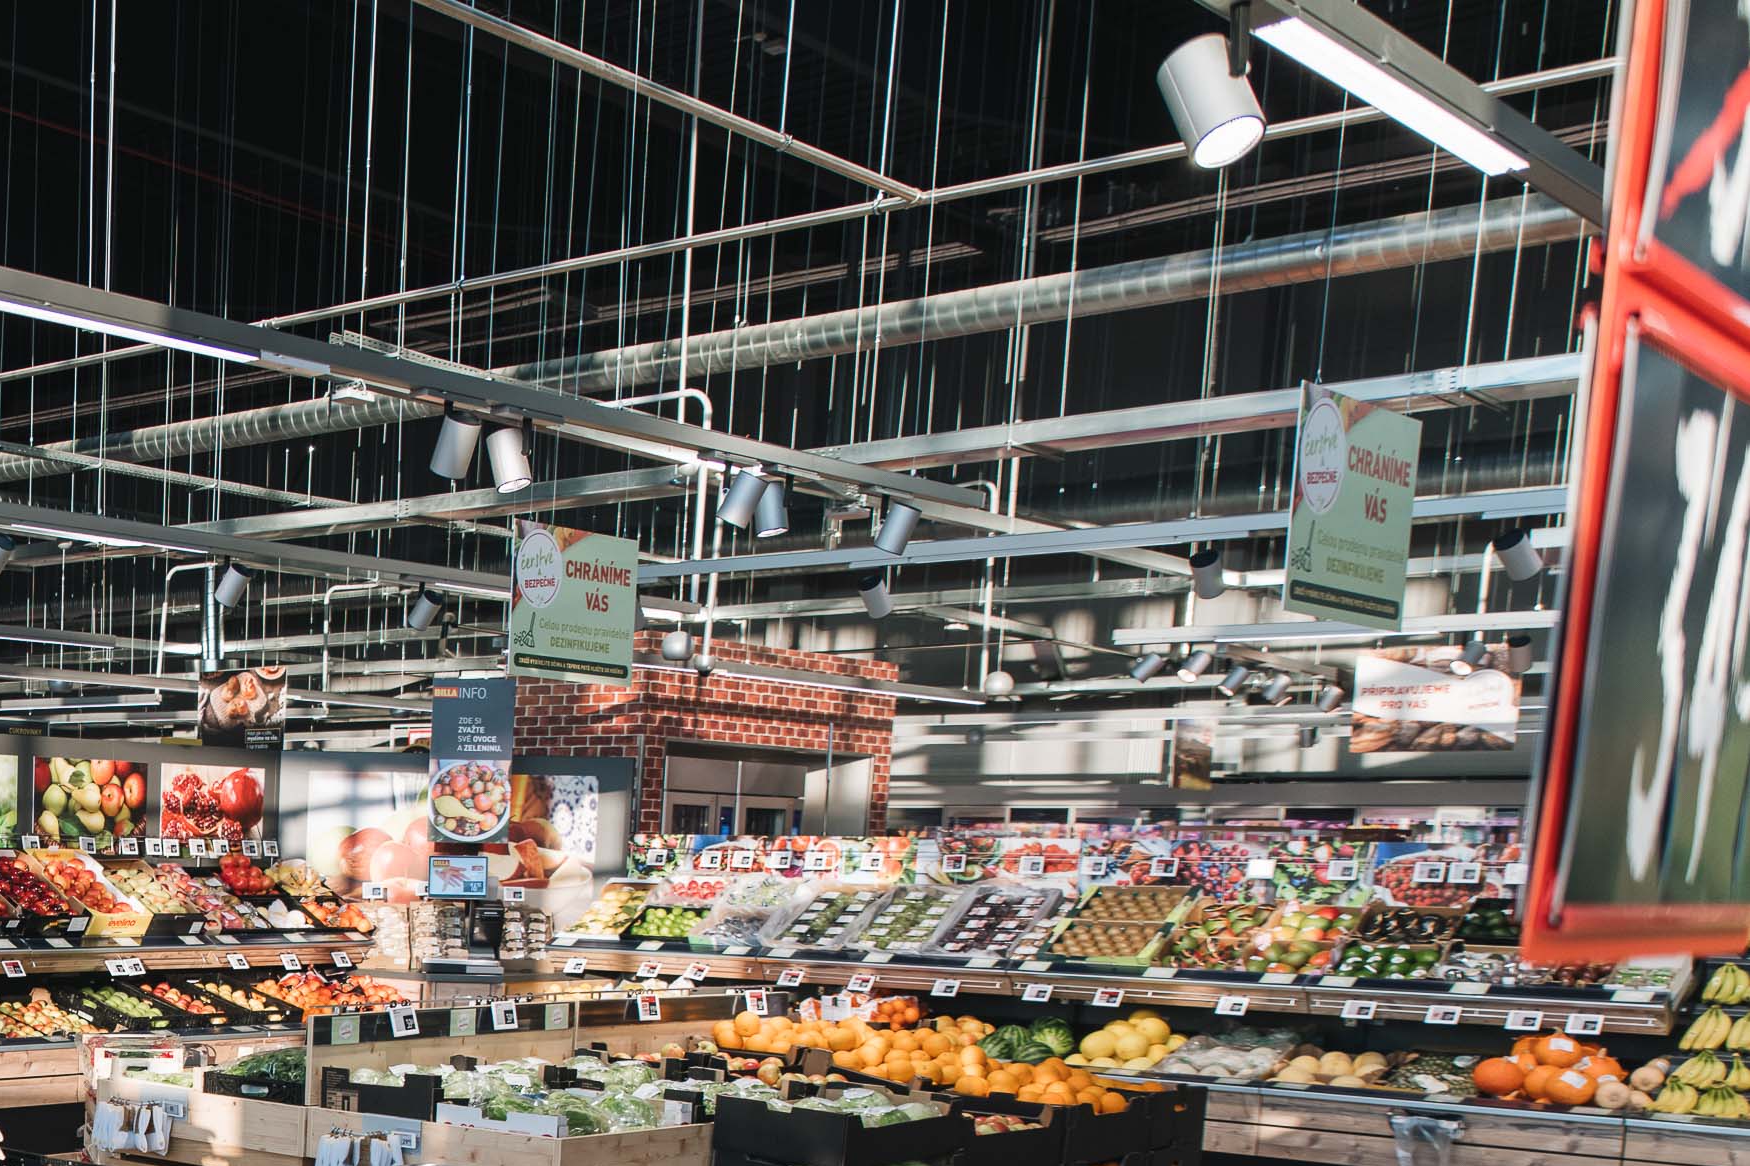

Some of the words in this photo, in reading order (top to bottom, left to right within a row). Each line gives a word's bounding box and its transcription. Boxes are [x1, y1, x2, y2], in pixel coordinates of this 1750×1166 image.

[1346, 445, 1411, 488] CHRÁNÍME
[1364, 487, 1387, 524] VÁS
[566, 559, 632, 587] CHRÁNÍME
[585, 588, 610, 613] VÁS
[434, 688, 458, 696] BILLA
[458, 725, 485, 733] ZVAŽTE
[458, 734, 471, 742] SVÉ
